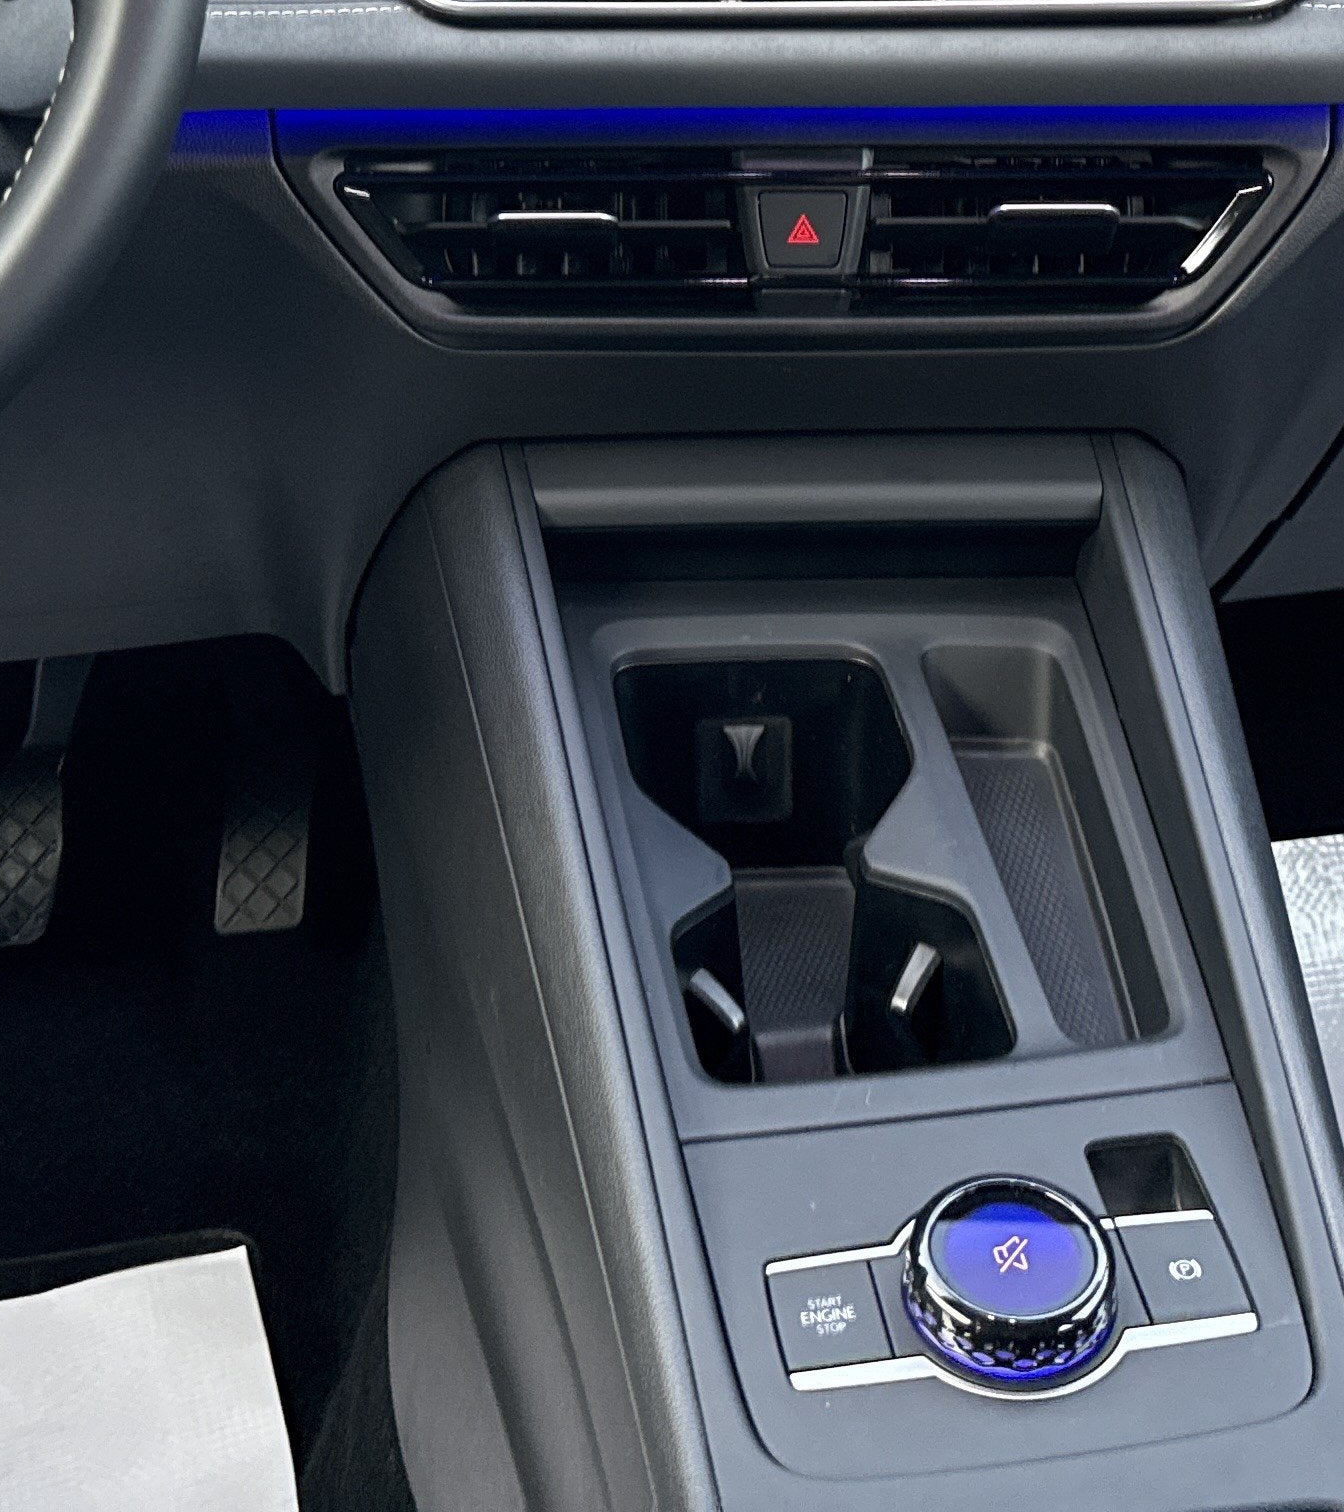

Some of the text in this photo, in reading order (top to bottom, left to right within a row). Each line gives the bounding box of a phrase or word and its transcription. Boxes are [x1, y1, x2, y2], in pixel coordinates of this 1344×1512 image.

[807, 1295, 842, 1310] START
[800, 1304, 856, 1326] ENGINE
[817, 1321, 847, 1336] STOP
